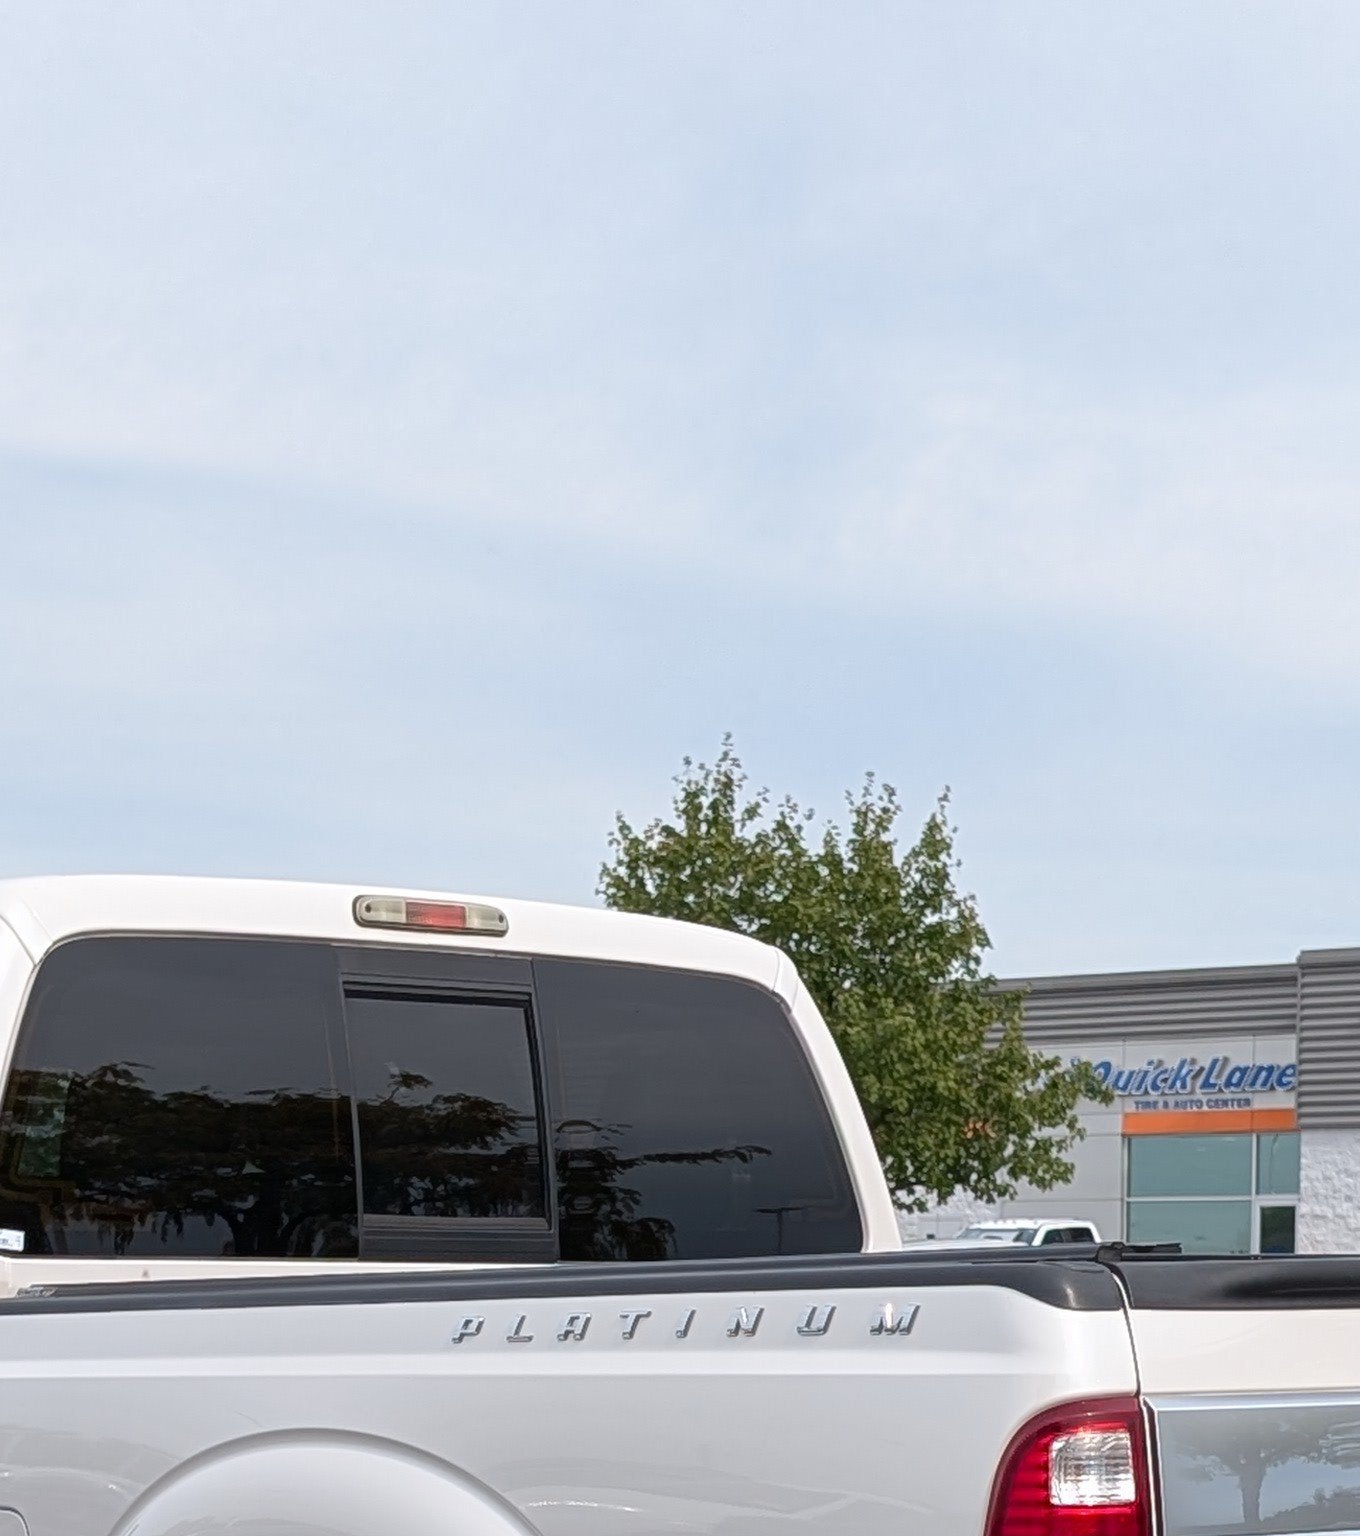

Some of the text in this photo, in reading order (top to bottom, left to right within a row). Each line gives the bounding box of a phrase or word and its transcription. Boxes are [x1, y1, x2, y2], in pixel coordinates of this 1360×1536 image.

[1198, 1055, 1298, 1092] Lane
[1174, 1099, 1203, 1110] AUTO
[1206, 1098, 1251, 1109] CENTER
[451, 1302, 920, 1345] PLATINUM
